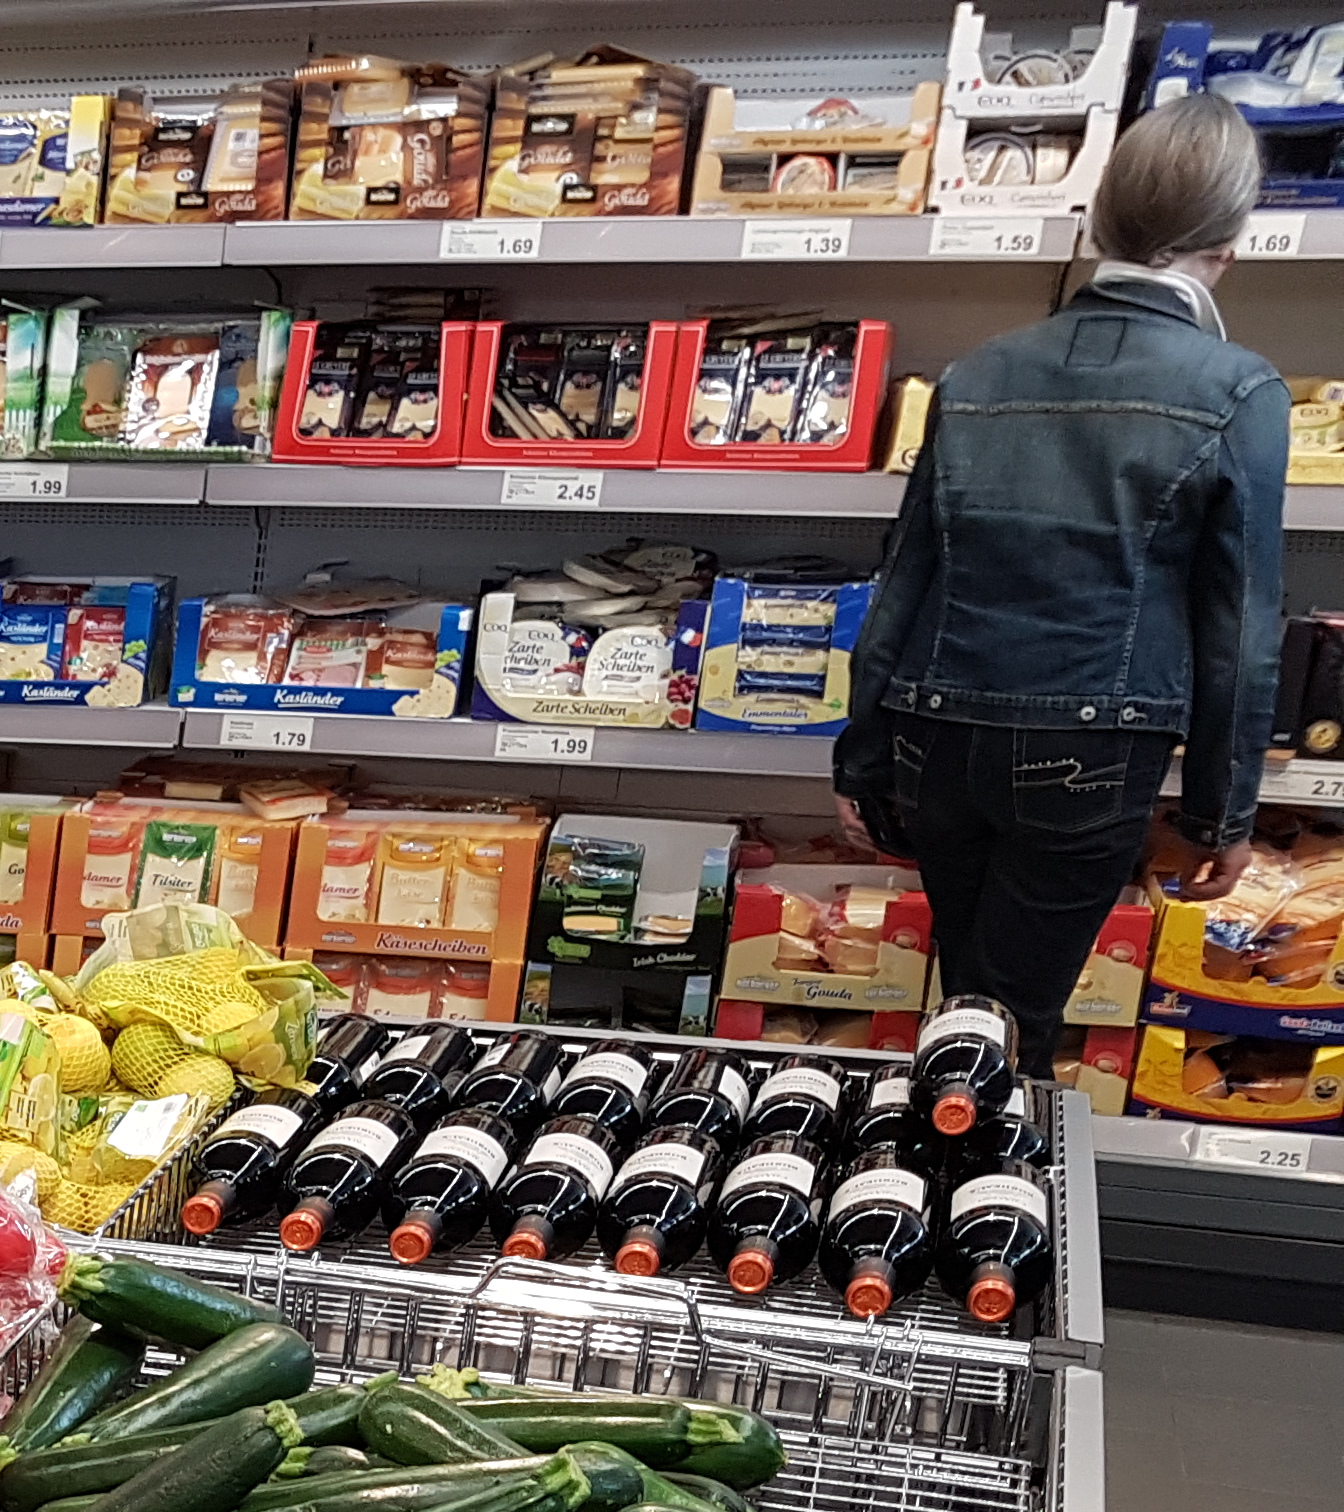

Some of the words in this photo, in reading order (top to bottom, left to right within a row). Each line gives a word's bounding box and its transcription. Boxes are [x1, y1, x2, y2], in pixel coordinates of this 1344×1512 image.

[498, 238, 534, 255] 1.69
[804, 237, 842, 254] 1.39
[994, 235, 1034, 252] 1.59
[1248, 234, 1292, 253] 1.69
[30, 481, 62, 495] 1.99
[557, 484, 597, 501] 2.45
[504, 653, 551, 667] cheiben
[611, 648, 647, 661] Zarte
[598, 659, 655, 674] Scheiben
[21, 684, 80, 701] Kasländer
[274, 689, 344, 709] Kasländer
[533, 701, 568, 714] Zarte
[569, 703, 628, 717] Scheiben
[272, 732, 306, 747] 1.79
[551, 739, 588, 754] 1.99
[1311, 780, 1344, 797] 2.7
[151, 873, 194, 890] Tilsiter
[375, 931, 489, 957] Käsescheiben
[806, 986, 853, 1001] Gouda
[1259, 1150, 1301, 1167] 2.25
